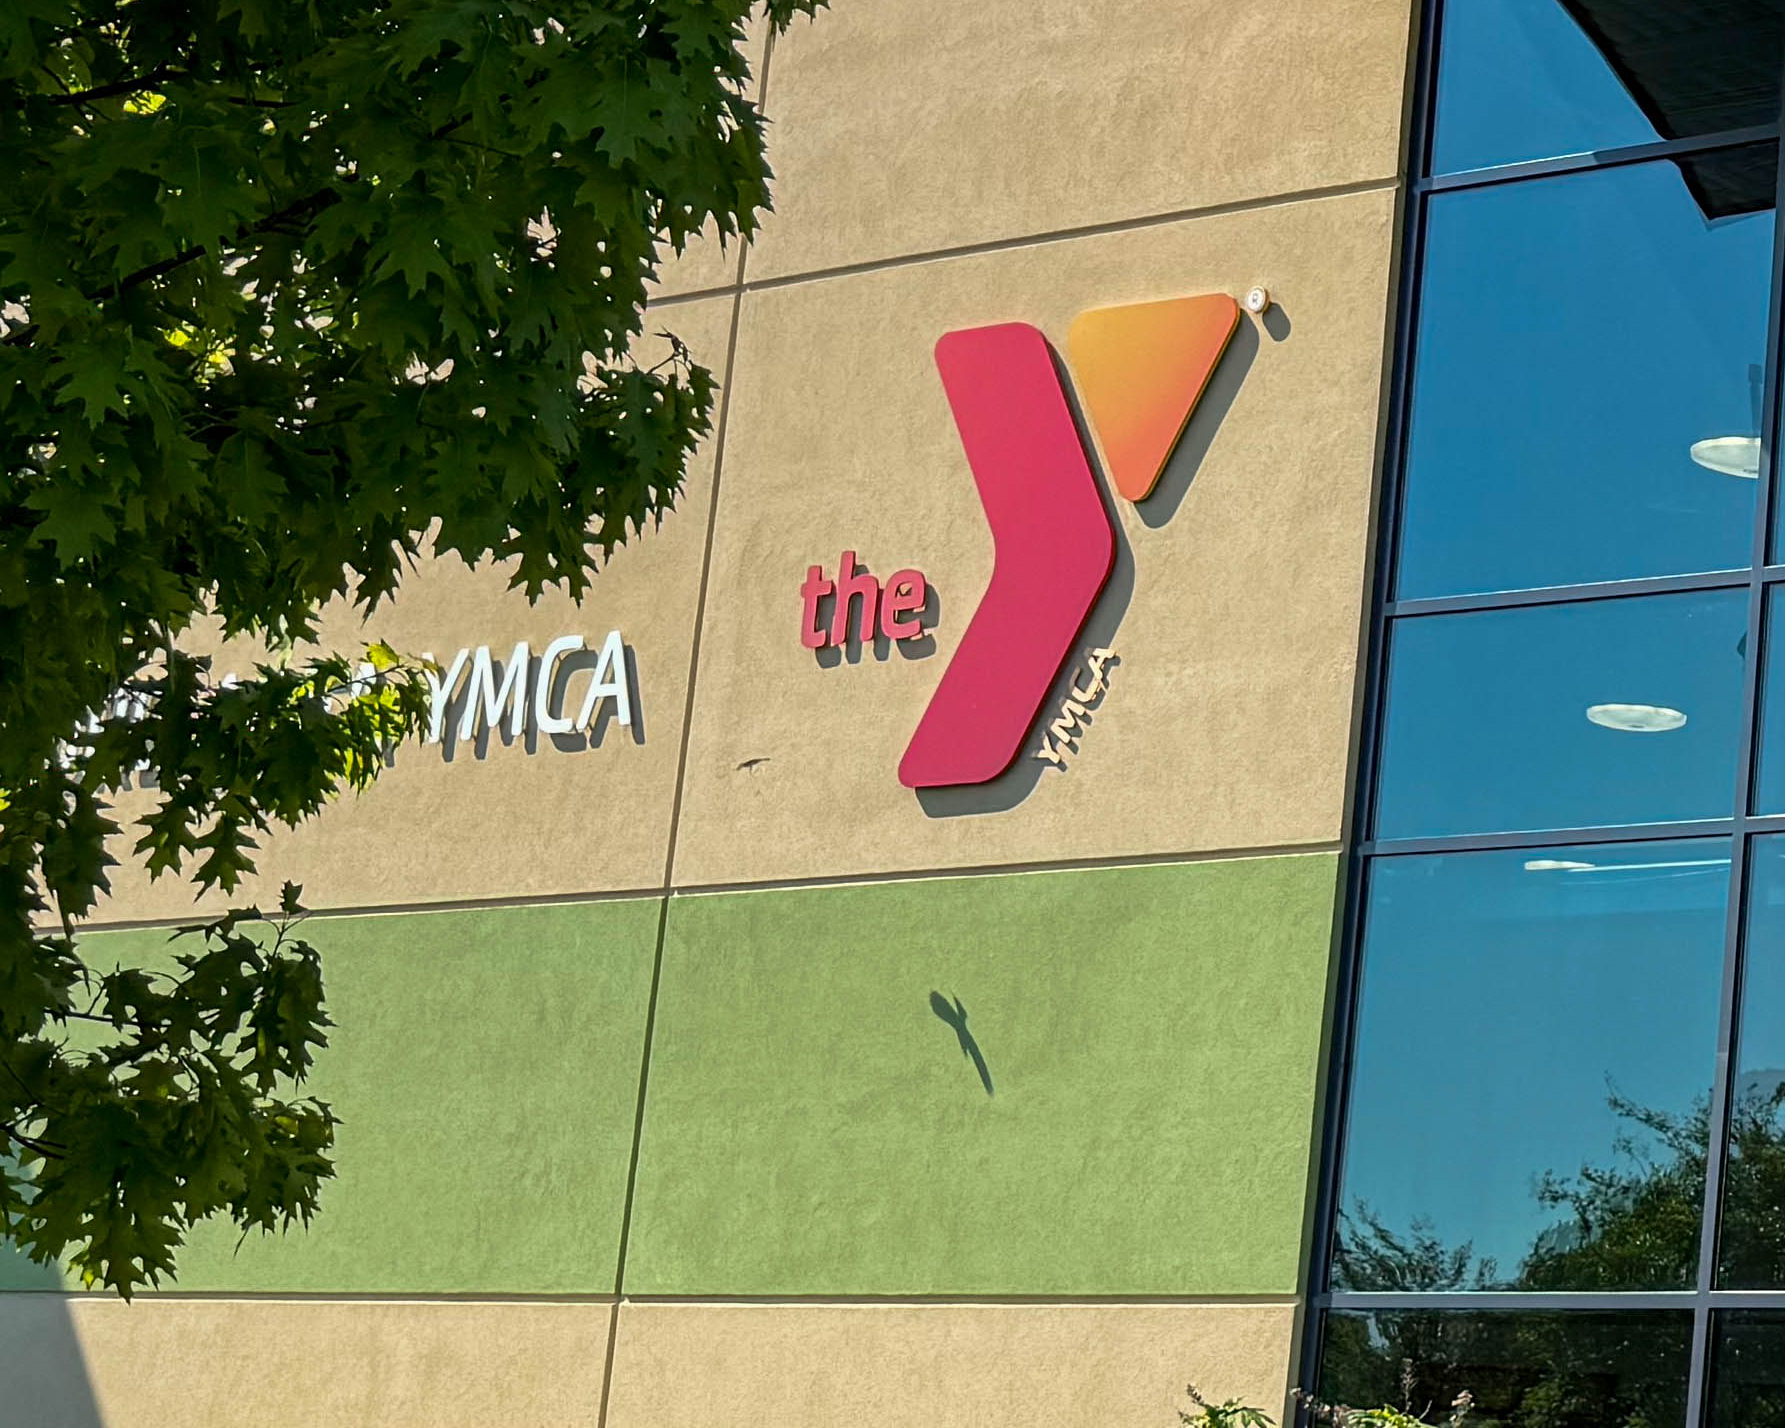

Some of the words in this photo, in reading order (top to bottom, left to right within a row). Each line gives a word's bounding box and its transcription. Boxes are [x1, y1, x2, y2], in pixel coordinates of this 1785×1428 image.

[801, 550, 927, 648] the
[422, 629, 632, 744] YMCA
[1033, 647, 1117, 765] YMCA
